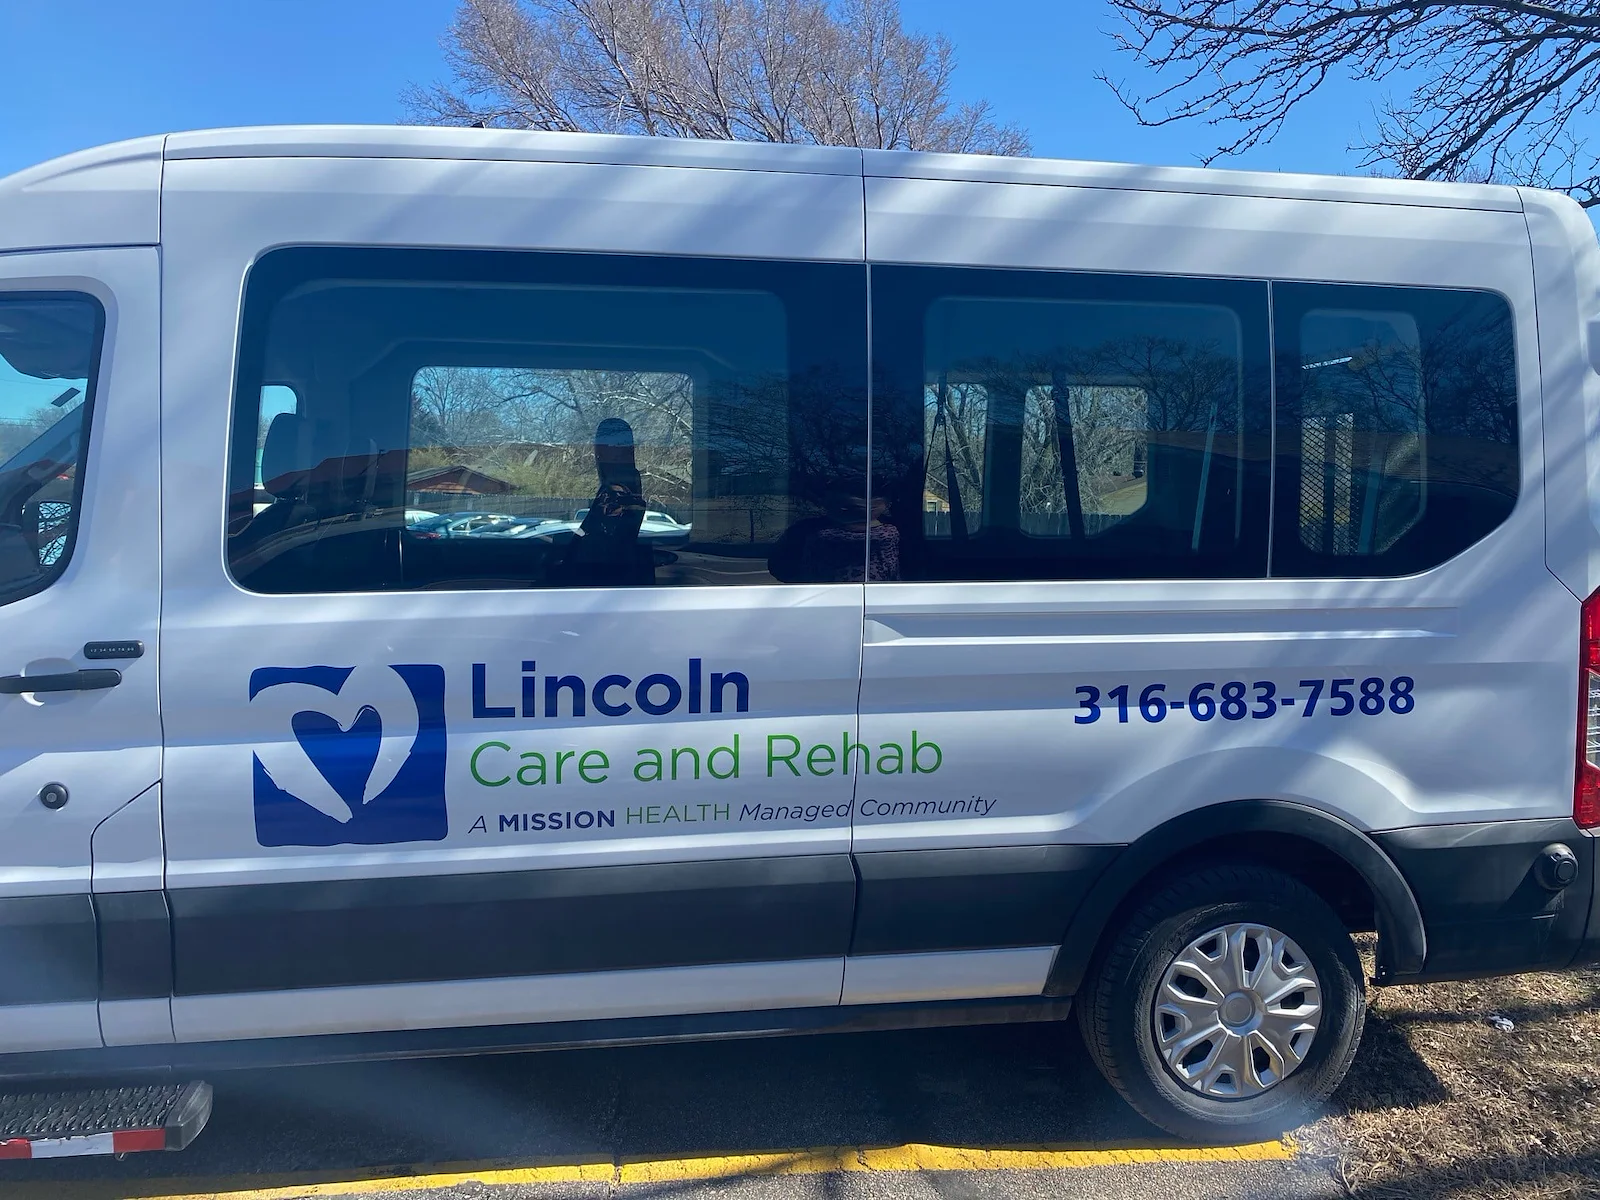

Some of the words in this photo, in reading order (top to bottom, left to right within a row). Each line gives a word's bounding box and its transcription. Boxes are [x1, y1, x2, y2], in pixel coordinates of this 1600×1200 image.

[472, 658, 749, 718] Lincoln
[1074, 676, 1415, 724] 316-683-7588
[470, 741, 610, 787] Care
[633, 733, 740, 782] and
[766, 730, 943, 778] Rehab
[468, 815, 487, 834] A
[499, 810, 615, 832] MISSION
[626, 803, 730, 825] HEALTH
[739, 799, 854, 822] Managed
[860, 795, 997, 817] Community
